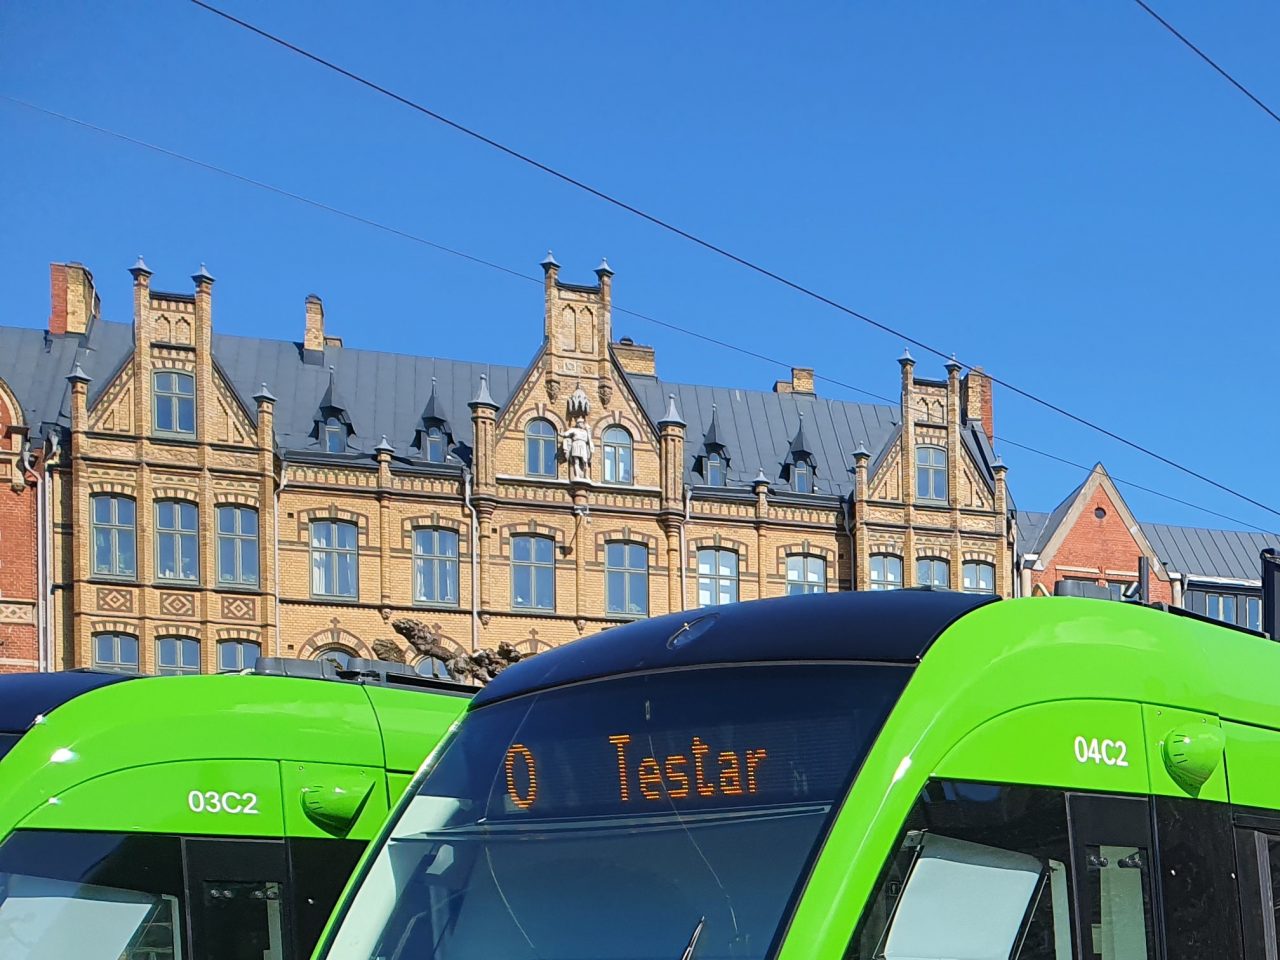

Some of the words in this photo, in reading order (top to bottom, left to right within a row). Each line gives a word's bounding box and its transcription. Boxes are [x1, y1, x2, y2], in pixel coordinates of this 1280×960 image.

[1074, 735, 1129, 767] 04C2
[608, 734, 767, 801] Testar
[188, 790, 260, 814] 03C2
